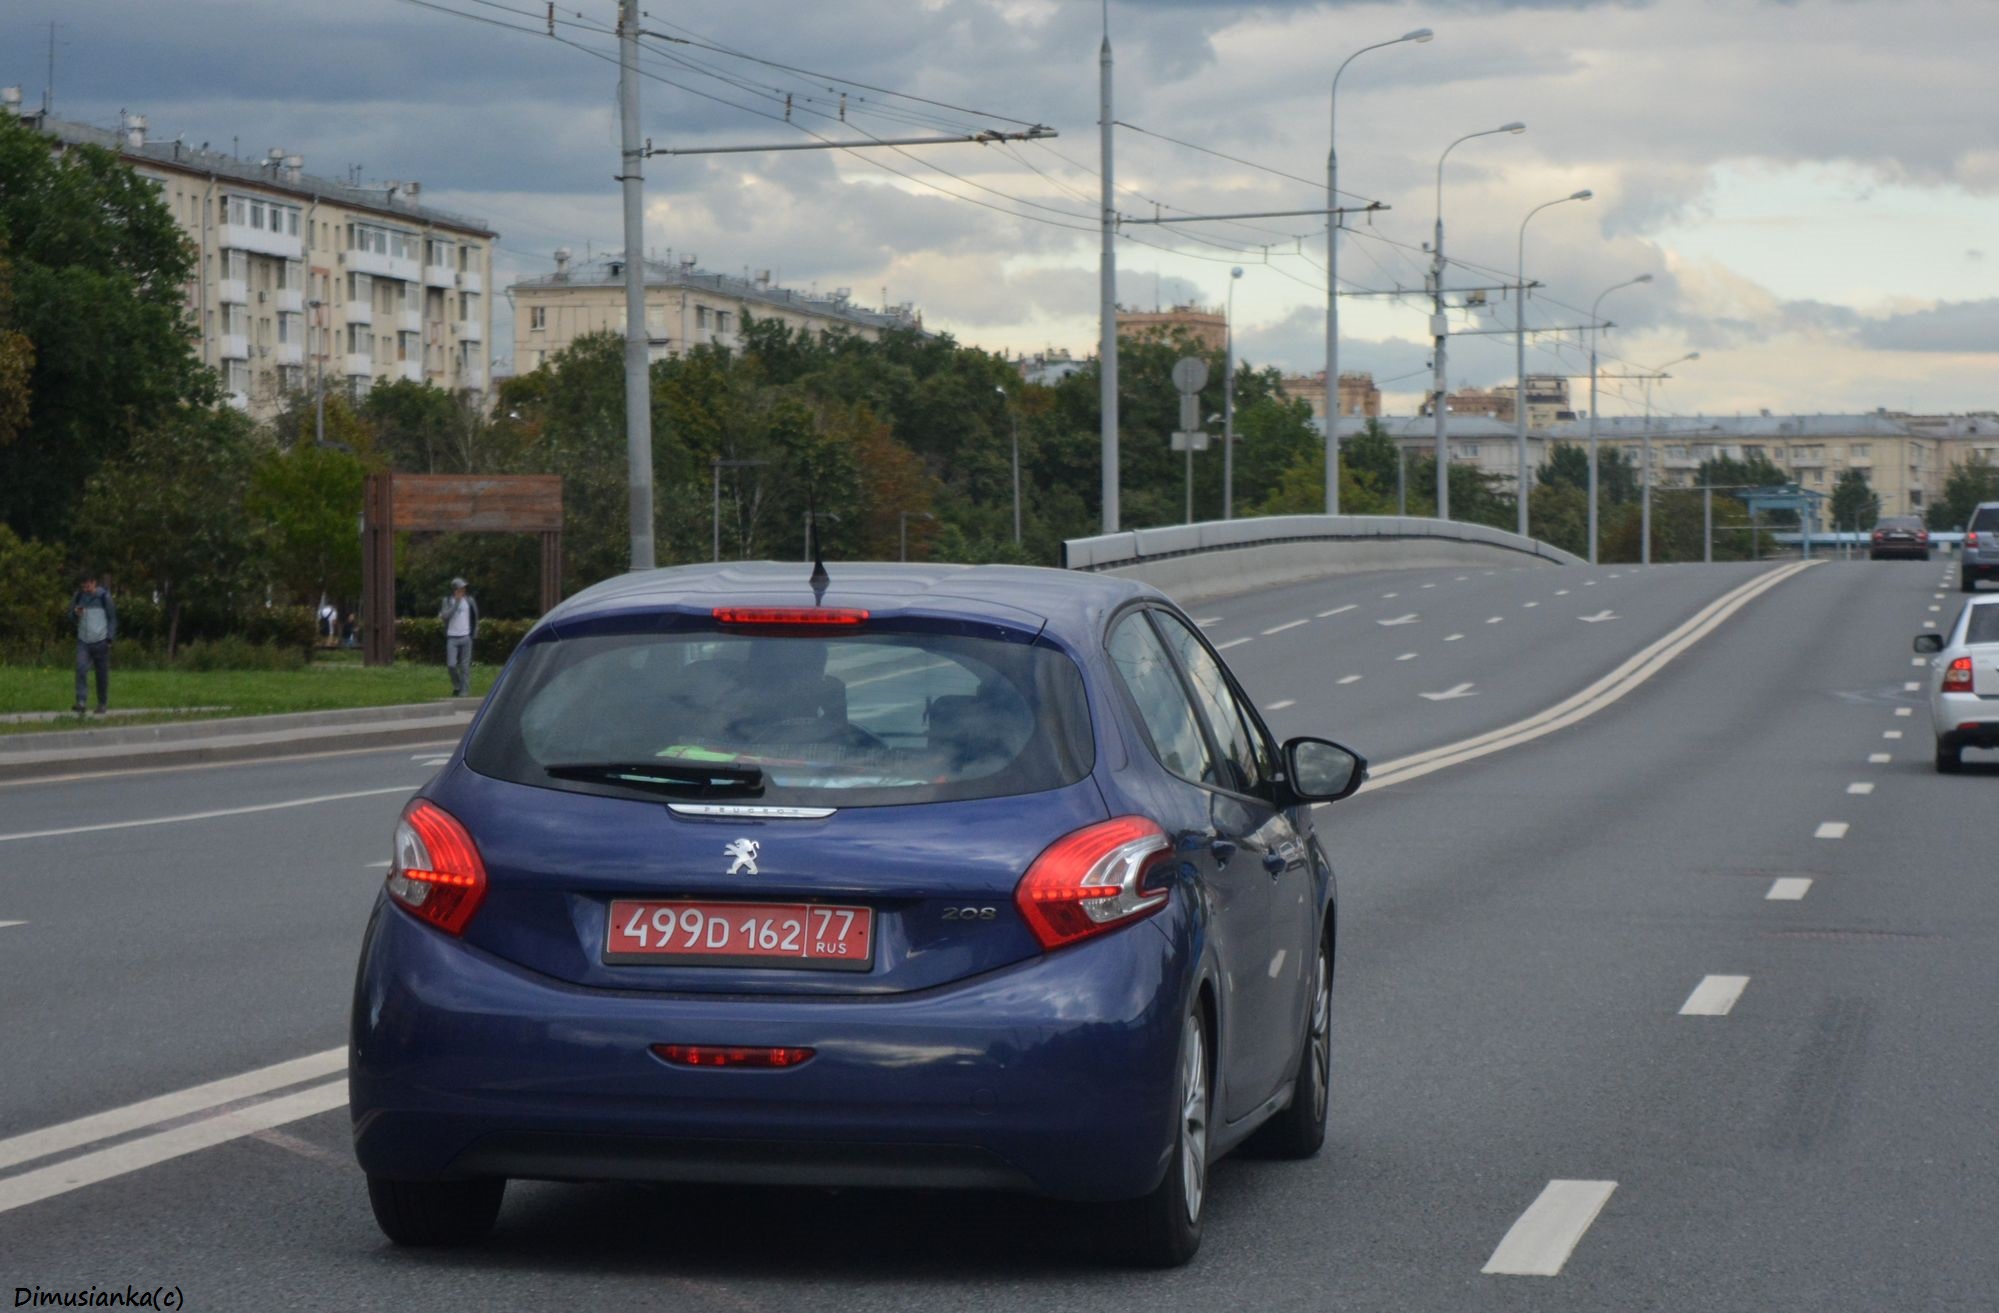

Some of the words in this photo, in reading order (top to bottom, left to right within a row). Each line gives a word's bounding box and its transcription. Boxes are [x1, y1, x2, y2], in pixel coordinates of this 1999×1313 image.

[704, 807, 800, 815] PEUGEOT
[942, 907, 997, 920] 208
[623, 907, 730, 949] 499D
[739, 918, 801, 952] 162
[813, 909, 855, 941] 77
[816, 942, 847, 955] RUS
